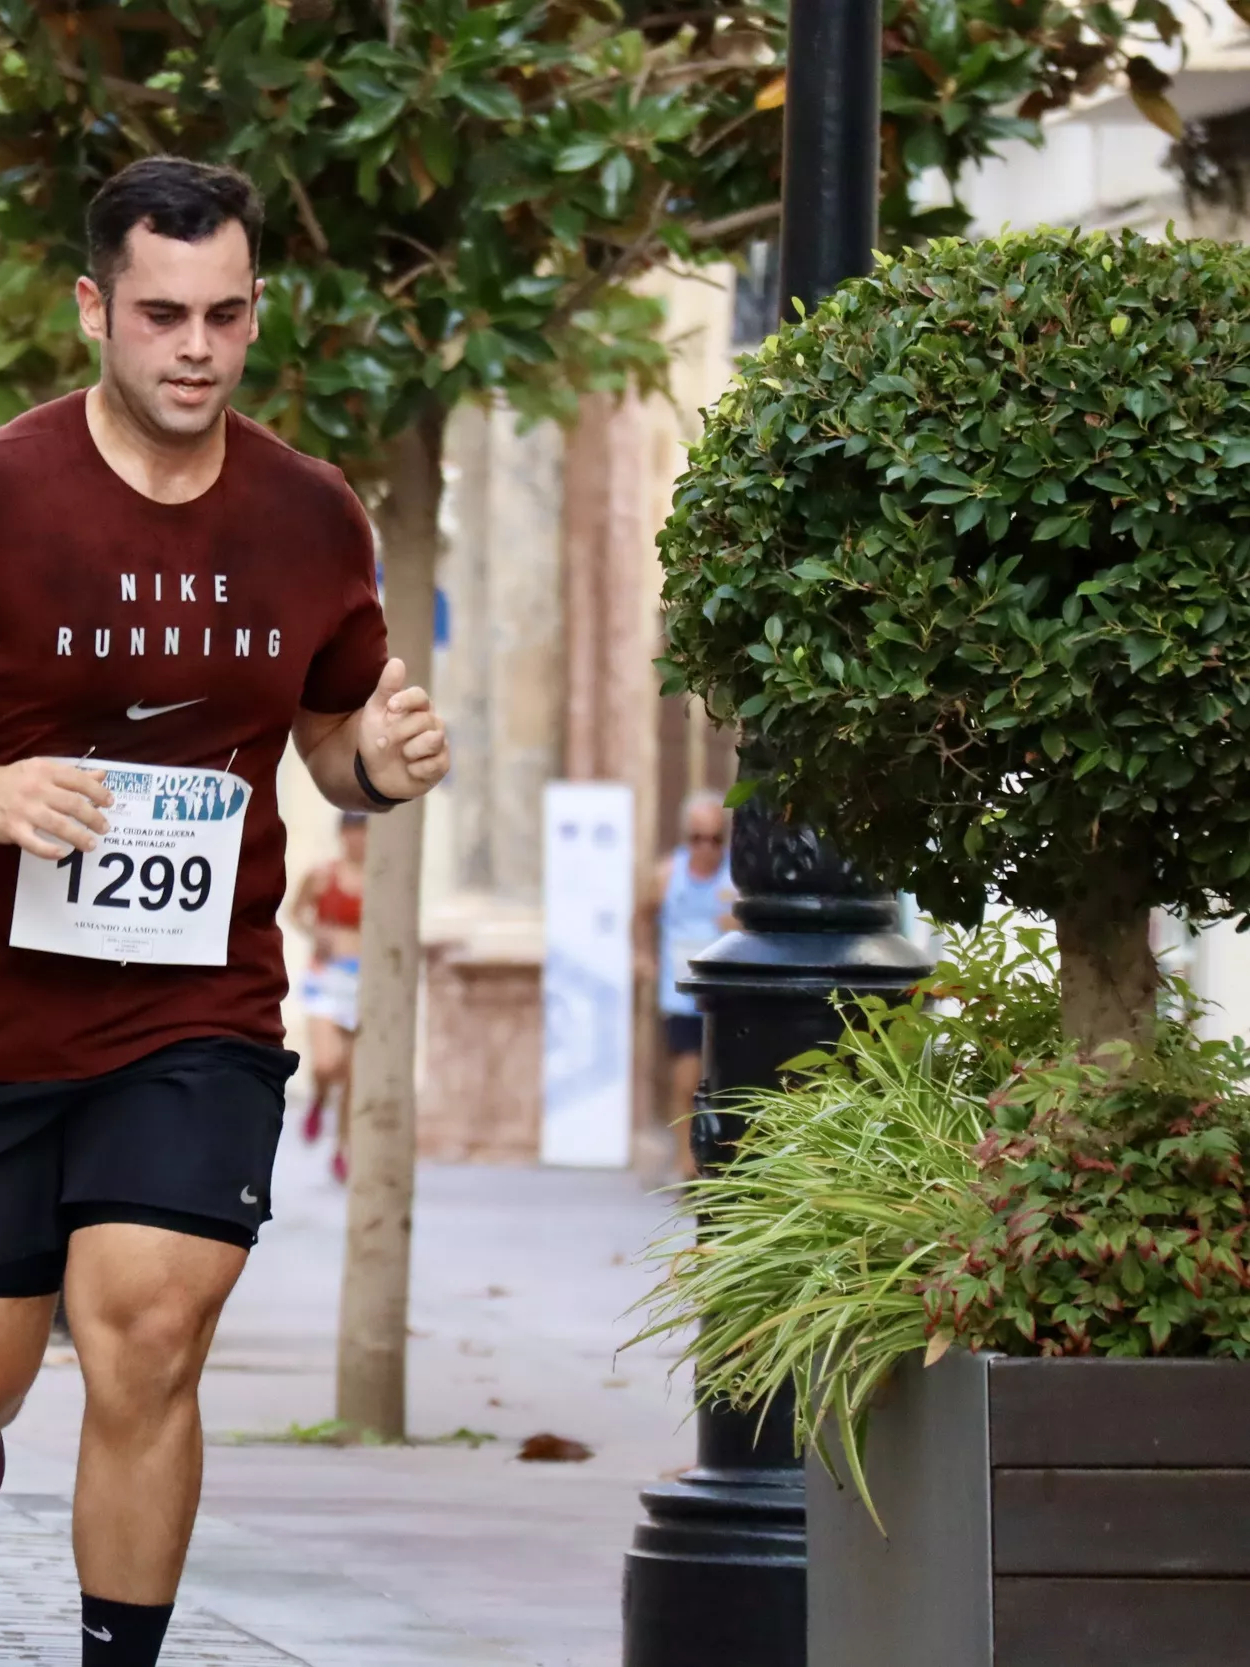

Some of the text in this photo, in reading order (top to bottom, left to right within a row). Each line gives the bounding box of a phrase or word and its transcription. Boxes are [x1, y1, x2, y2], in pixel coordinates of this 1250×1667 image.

[121, 573, 228, 602] NIKE
[57, 627, 281, 657] RUNNING
[101, 780, 152, 794] OPULARES
[153, 774, 206, 797] 2024
[123, 827, 153, 836] CIUDAD
[154, 829, 166, 837] DE
[167, 830, 196, 838] LUCENA
[103, 837, 176, 848] POR LA IGUALDAD
[56, 848, 212, 912] 1299
[73, 921, 184, 936] ARMANDO ALAMOS VARO
